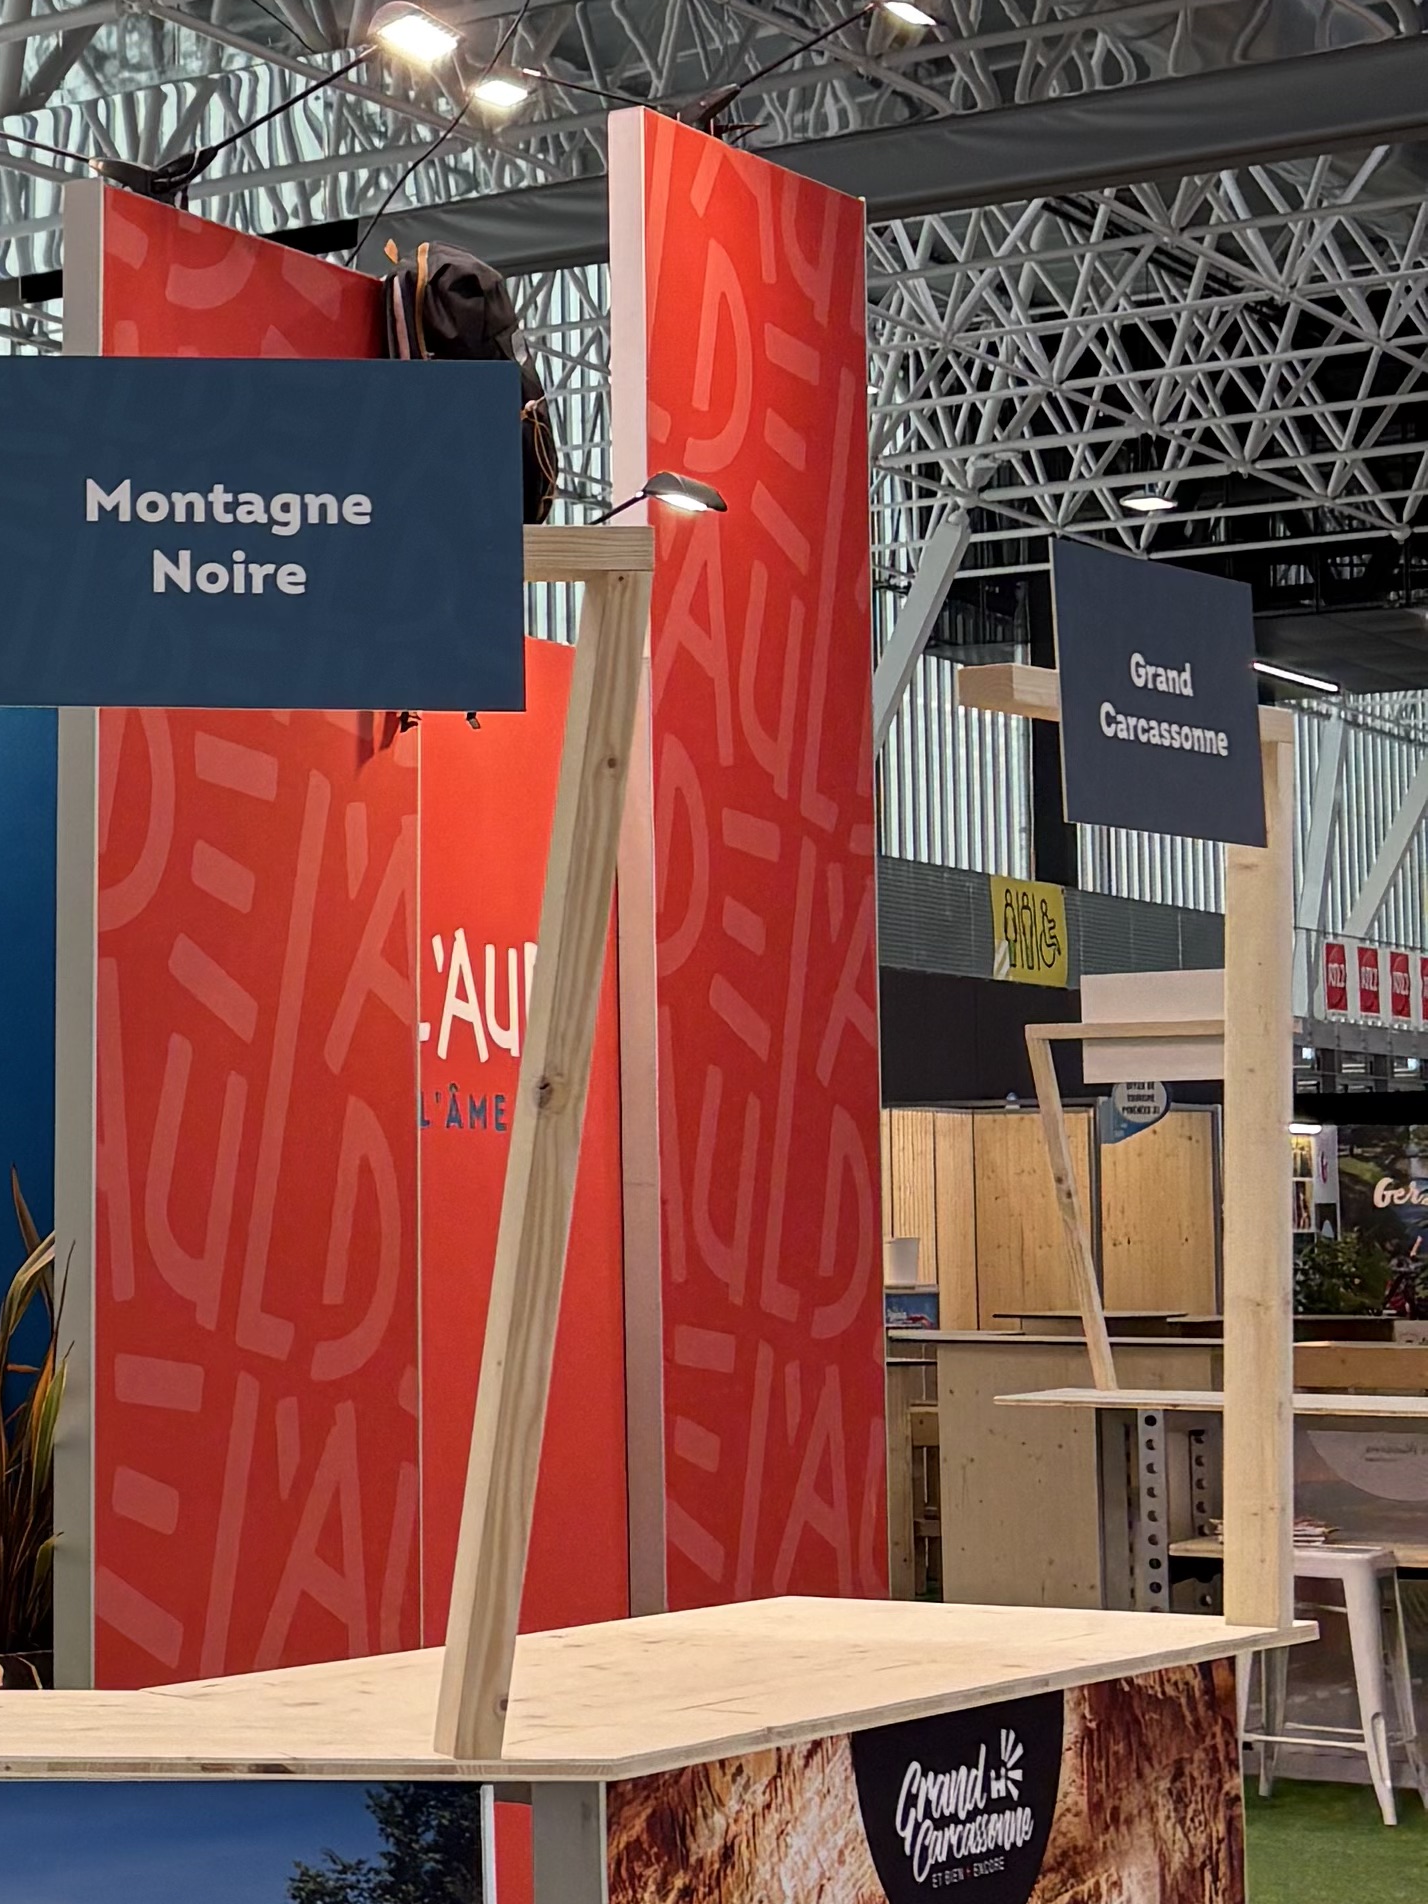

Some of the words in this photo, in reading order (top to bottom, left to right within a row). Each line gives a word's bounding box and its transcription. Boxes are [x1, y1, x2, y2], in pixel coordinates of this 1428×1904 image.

[86, 478, 372, 535] Montagne
[153, 548, 307, 595] Noire
[1130, 652, 1194, 698] Grand
[1099, 701, 1229, 758] Carcassonne
[895, 1743, 987, 1856] Grand
[913, 1807, 1034, 1883] Carcassonne
